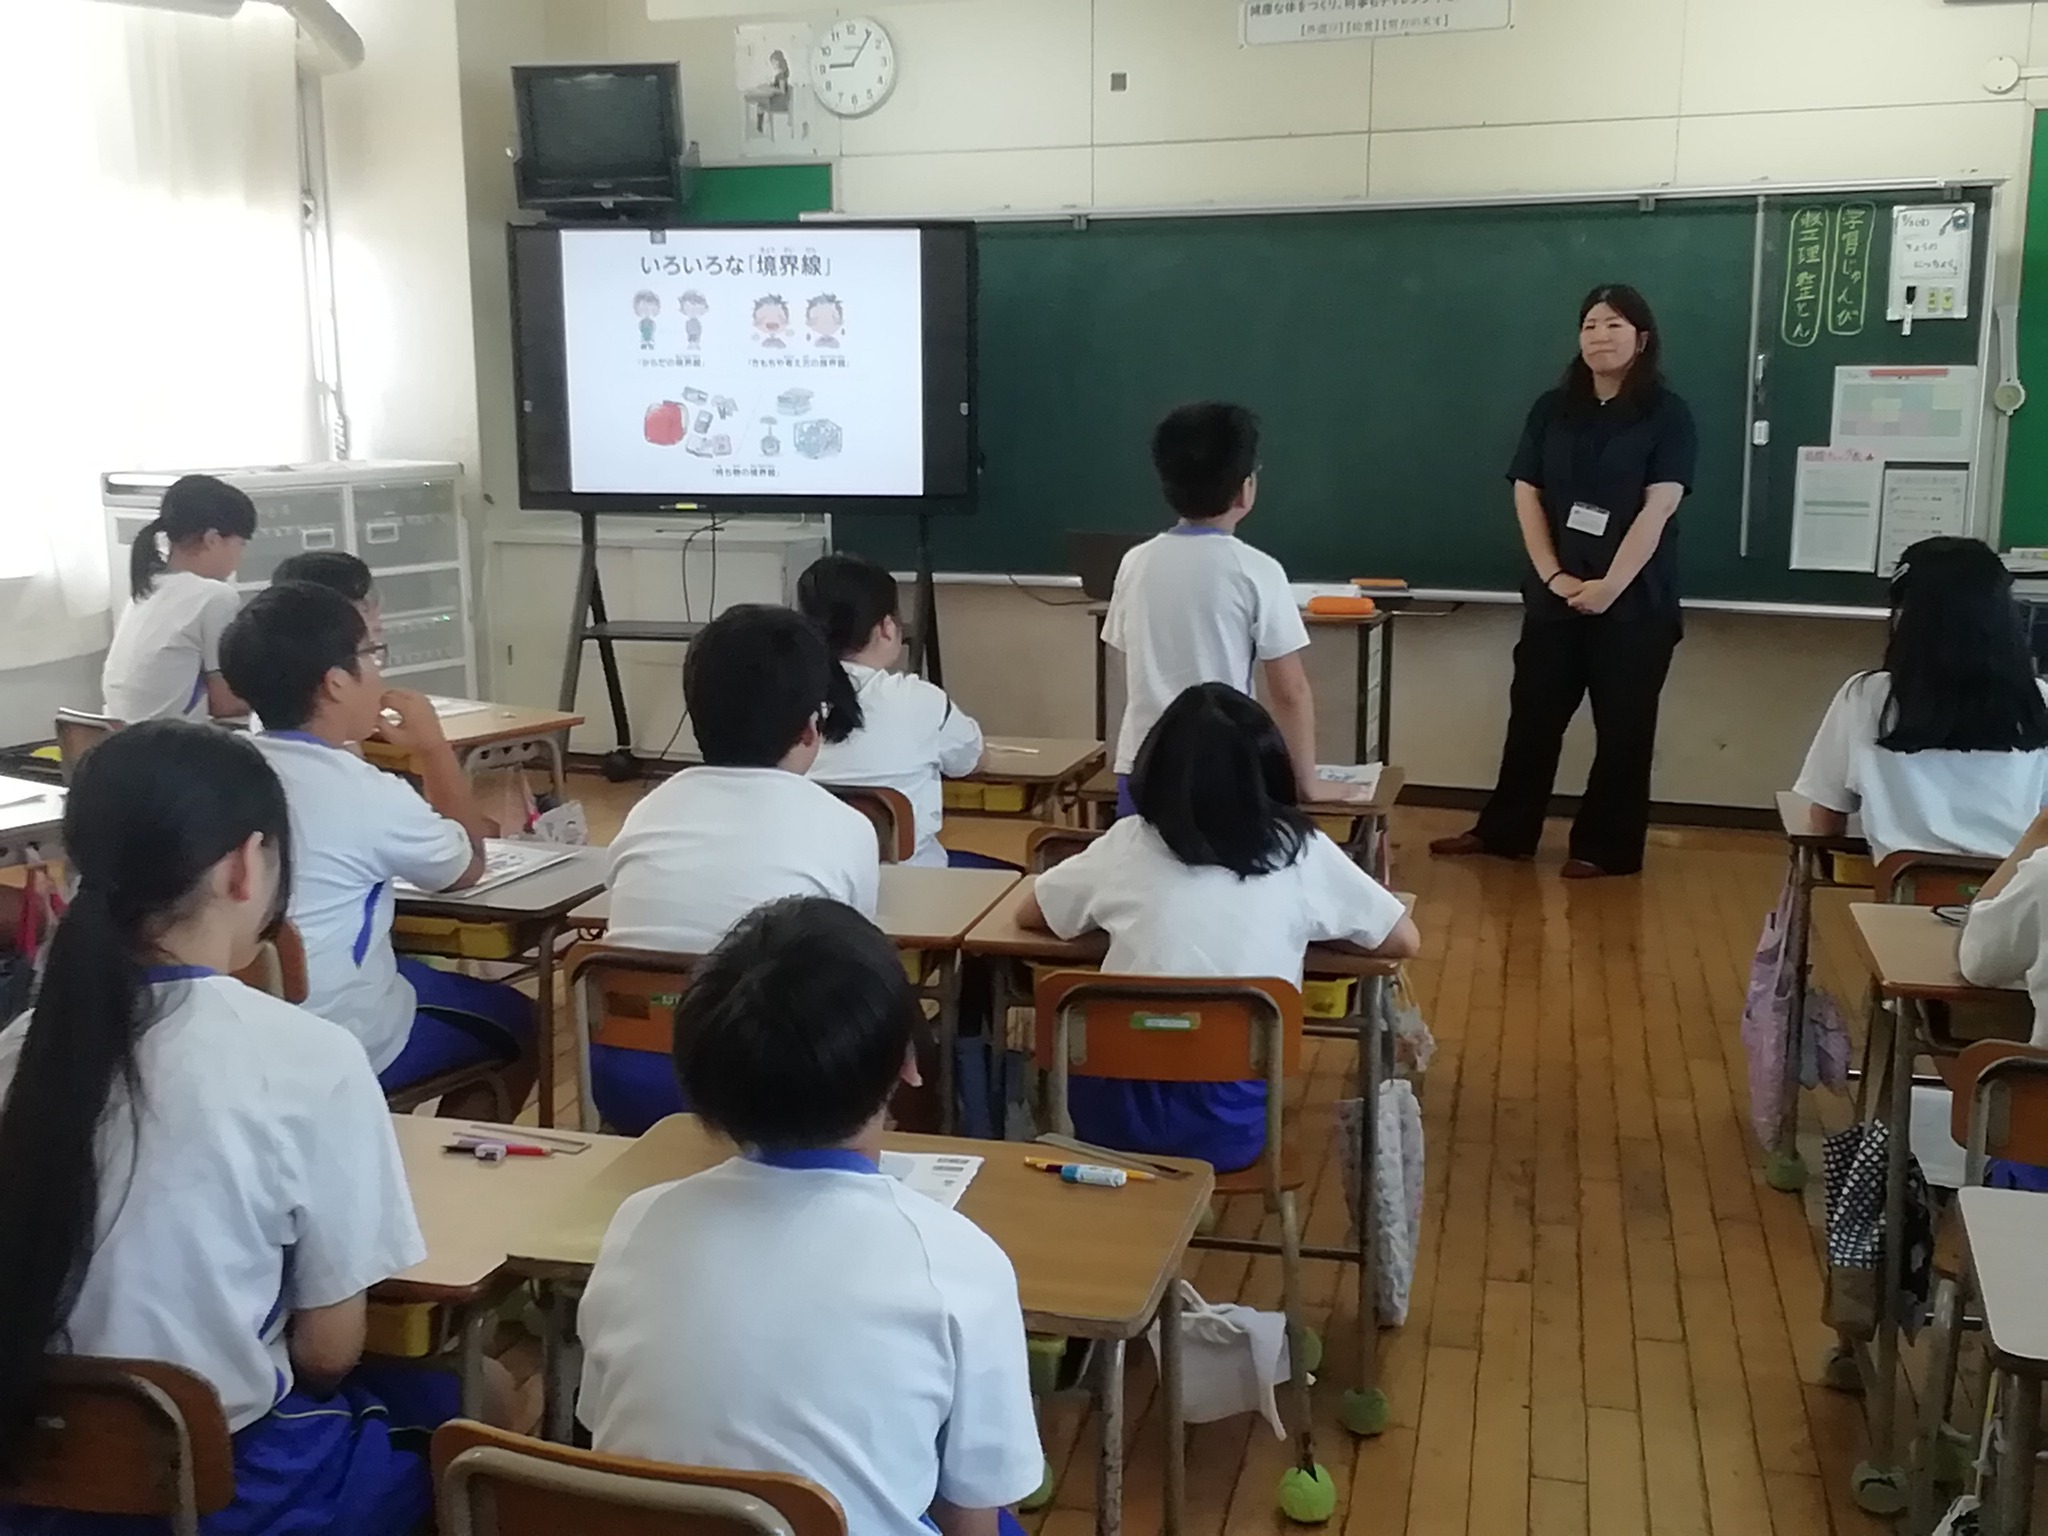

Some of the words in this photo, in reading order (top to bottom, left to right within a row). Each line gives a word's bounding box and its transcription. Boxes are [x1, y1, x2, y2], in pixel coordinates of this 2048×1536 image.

[846, 23, 856, 36] 12
[831, 31, 840, 42] 11
[820, 45, 832, 57] 10
[877, 75, 883, 85] 4
[838, 92, 844, 103] 7
[851, 94, 858, 105] 6
[866, 88, 873, 100] 5
[640, 254, 831, 277] いろいろな「境界線」
[1837, 208, 1866, 327] 学習じゅんび
